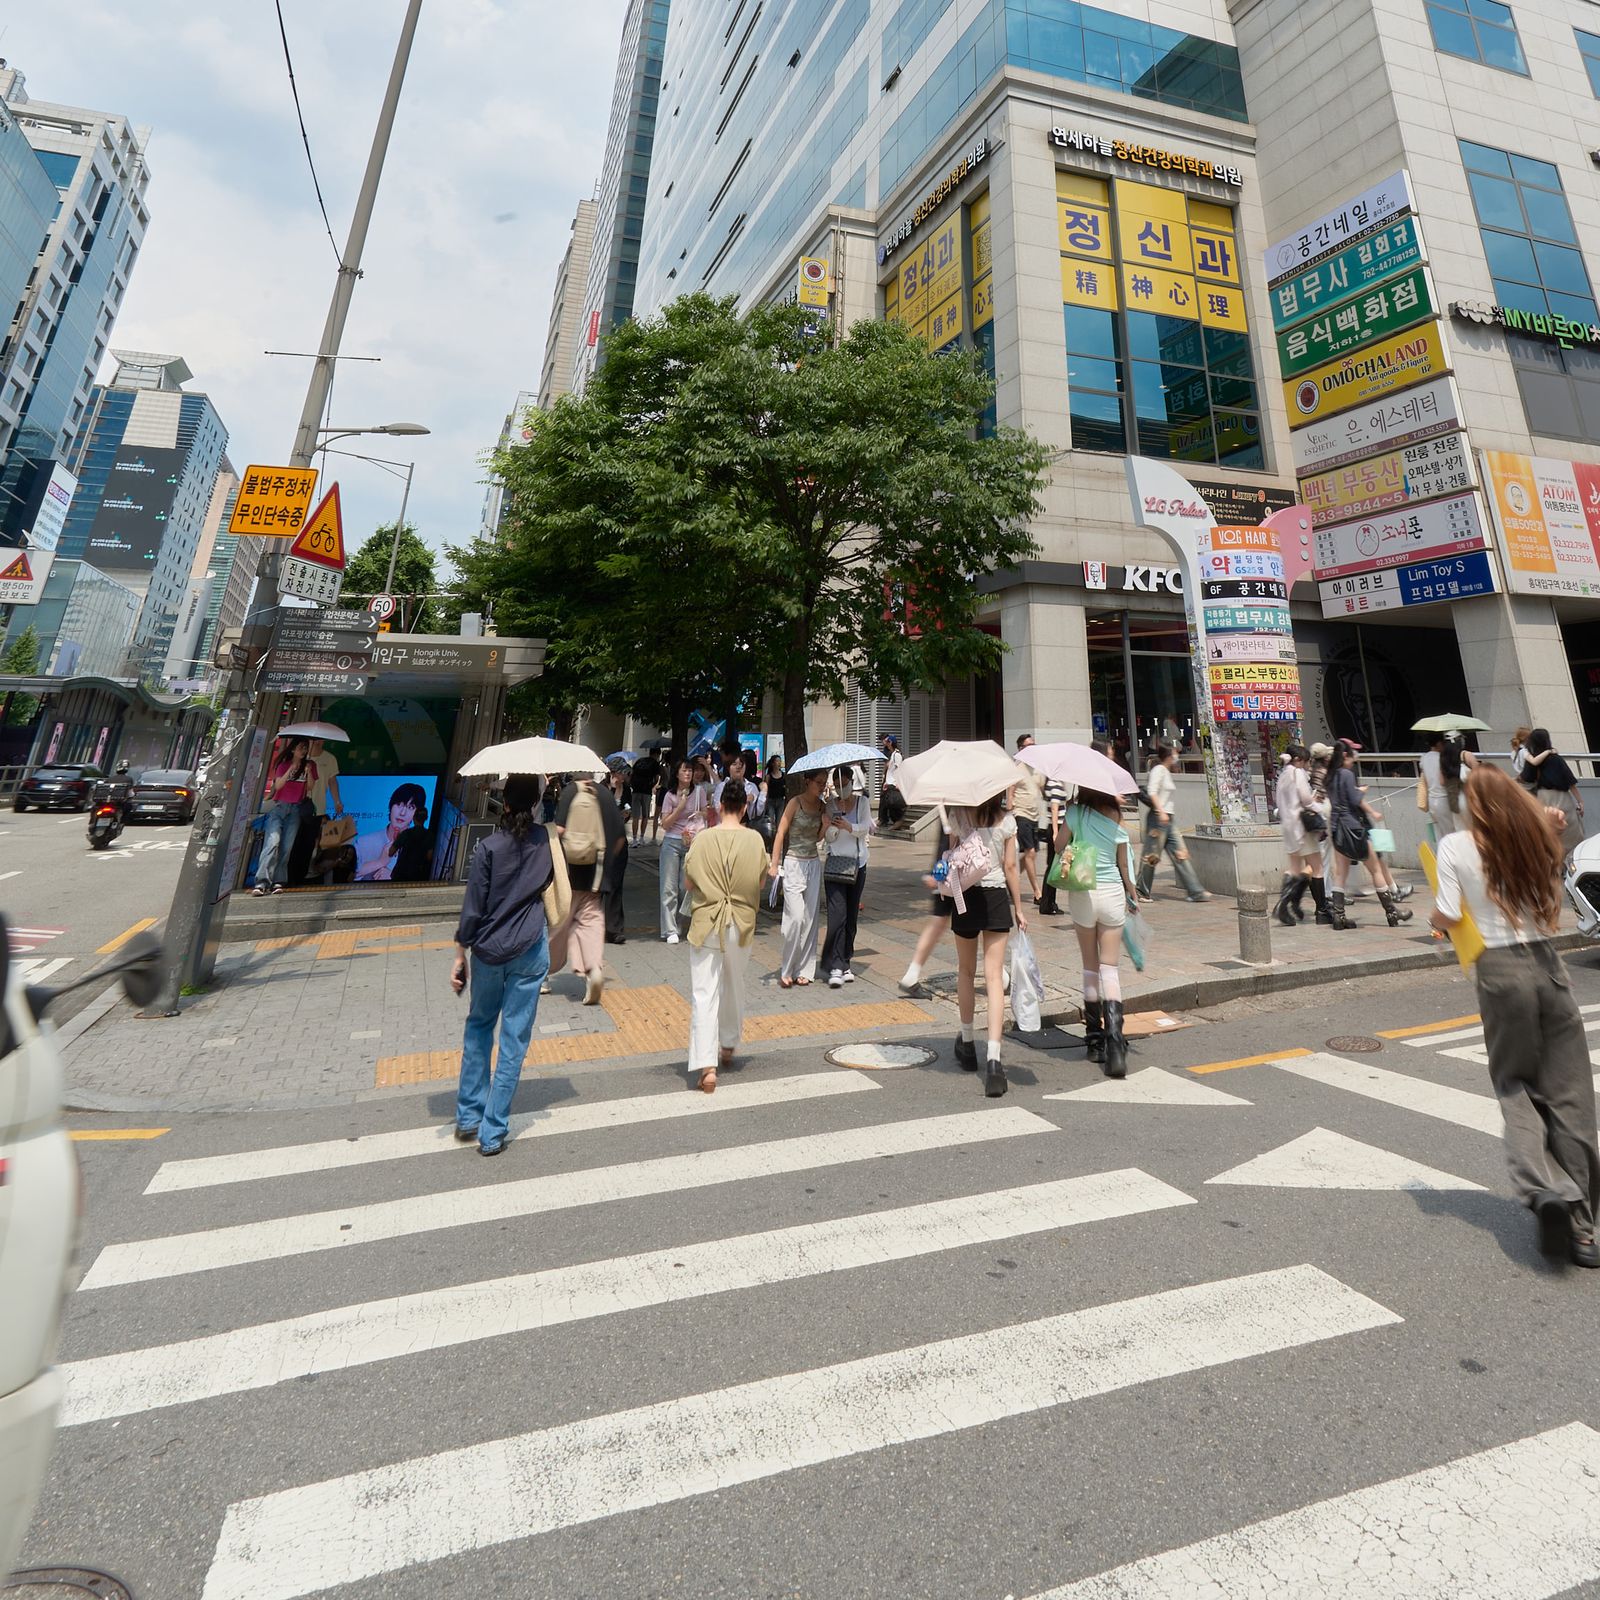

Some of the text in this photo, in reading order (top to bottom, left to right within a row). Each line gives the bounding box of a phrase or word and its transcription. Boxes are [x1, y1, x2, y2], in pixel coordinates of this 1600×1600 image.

[1376, 194, 1388, 207] 6F
[1297, 200, 1370, 258] 공간네일
[904, 227, 954, 300] 정신과
[1278, 223, 1408, 318] 법무사 김회규
[1286, 277, 1419, 359] 음식백화점
[1322, 338, 1428, 392] OMOCHALAND
[1379, 366, 1400, 381] goods
[1407, 355, 1429, 369] Figure
[1404, 436, 1460, 463] 원룸 전문
[246, 474, 312, 498] 불법주정차
[1304, 475, 1338, 506] 백년
[1343, 457, 1399, 497] 부동산
[1543, 485, 1576, 501] ATOM
[237, 503, 304, 528] 무인단속중
[1198, 535, 1209, 545] 2F
[1218, 530, 1268, 545] VOG HAIR
[1211, 555, 1230, 575] 약
[1408, 561, 1465, 582] Lim Toy S
[0, 581, 34, 591] 방50m
[1122, 565, 1184, 594] KFC
[1332, 574, 1384, 595] 아이러브
[1528, 577, 1560, 590] 홍대입구역
[1562, 580, 1579, 591] 2호선
[1210, 582, 1286, 598] 6F 공간네일
[1411, 581, 1460, 601] 프라모델
[373, 599, 391, 613] 50
[1235, 610, 1274, 624] 법무사
[413, 649, 460, 658] Hongik Univ.
[489, 650, 498, 662] 9
